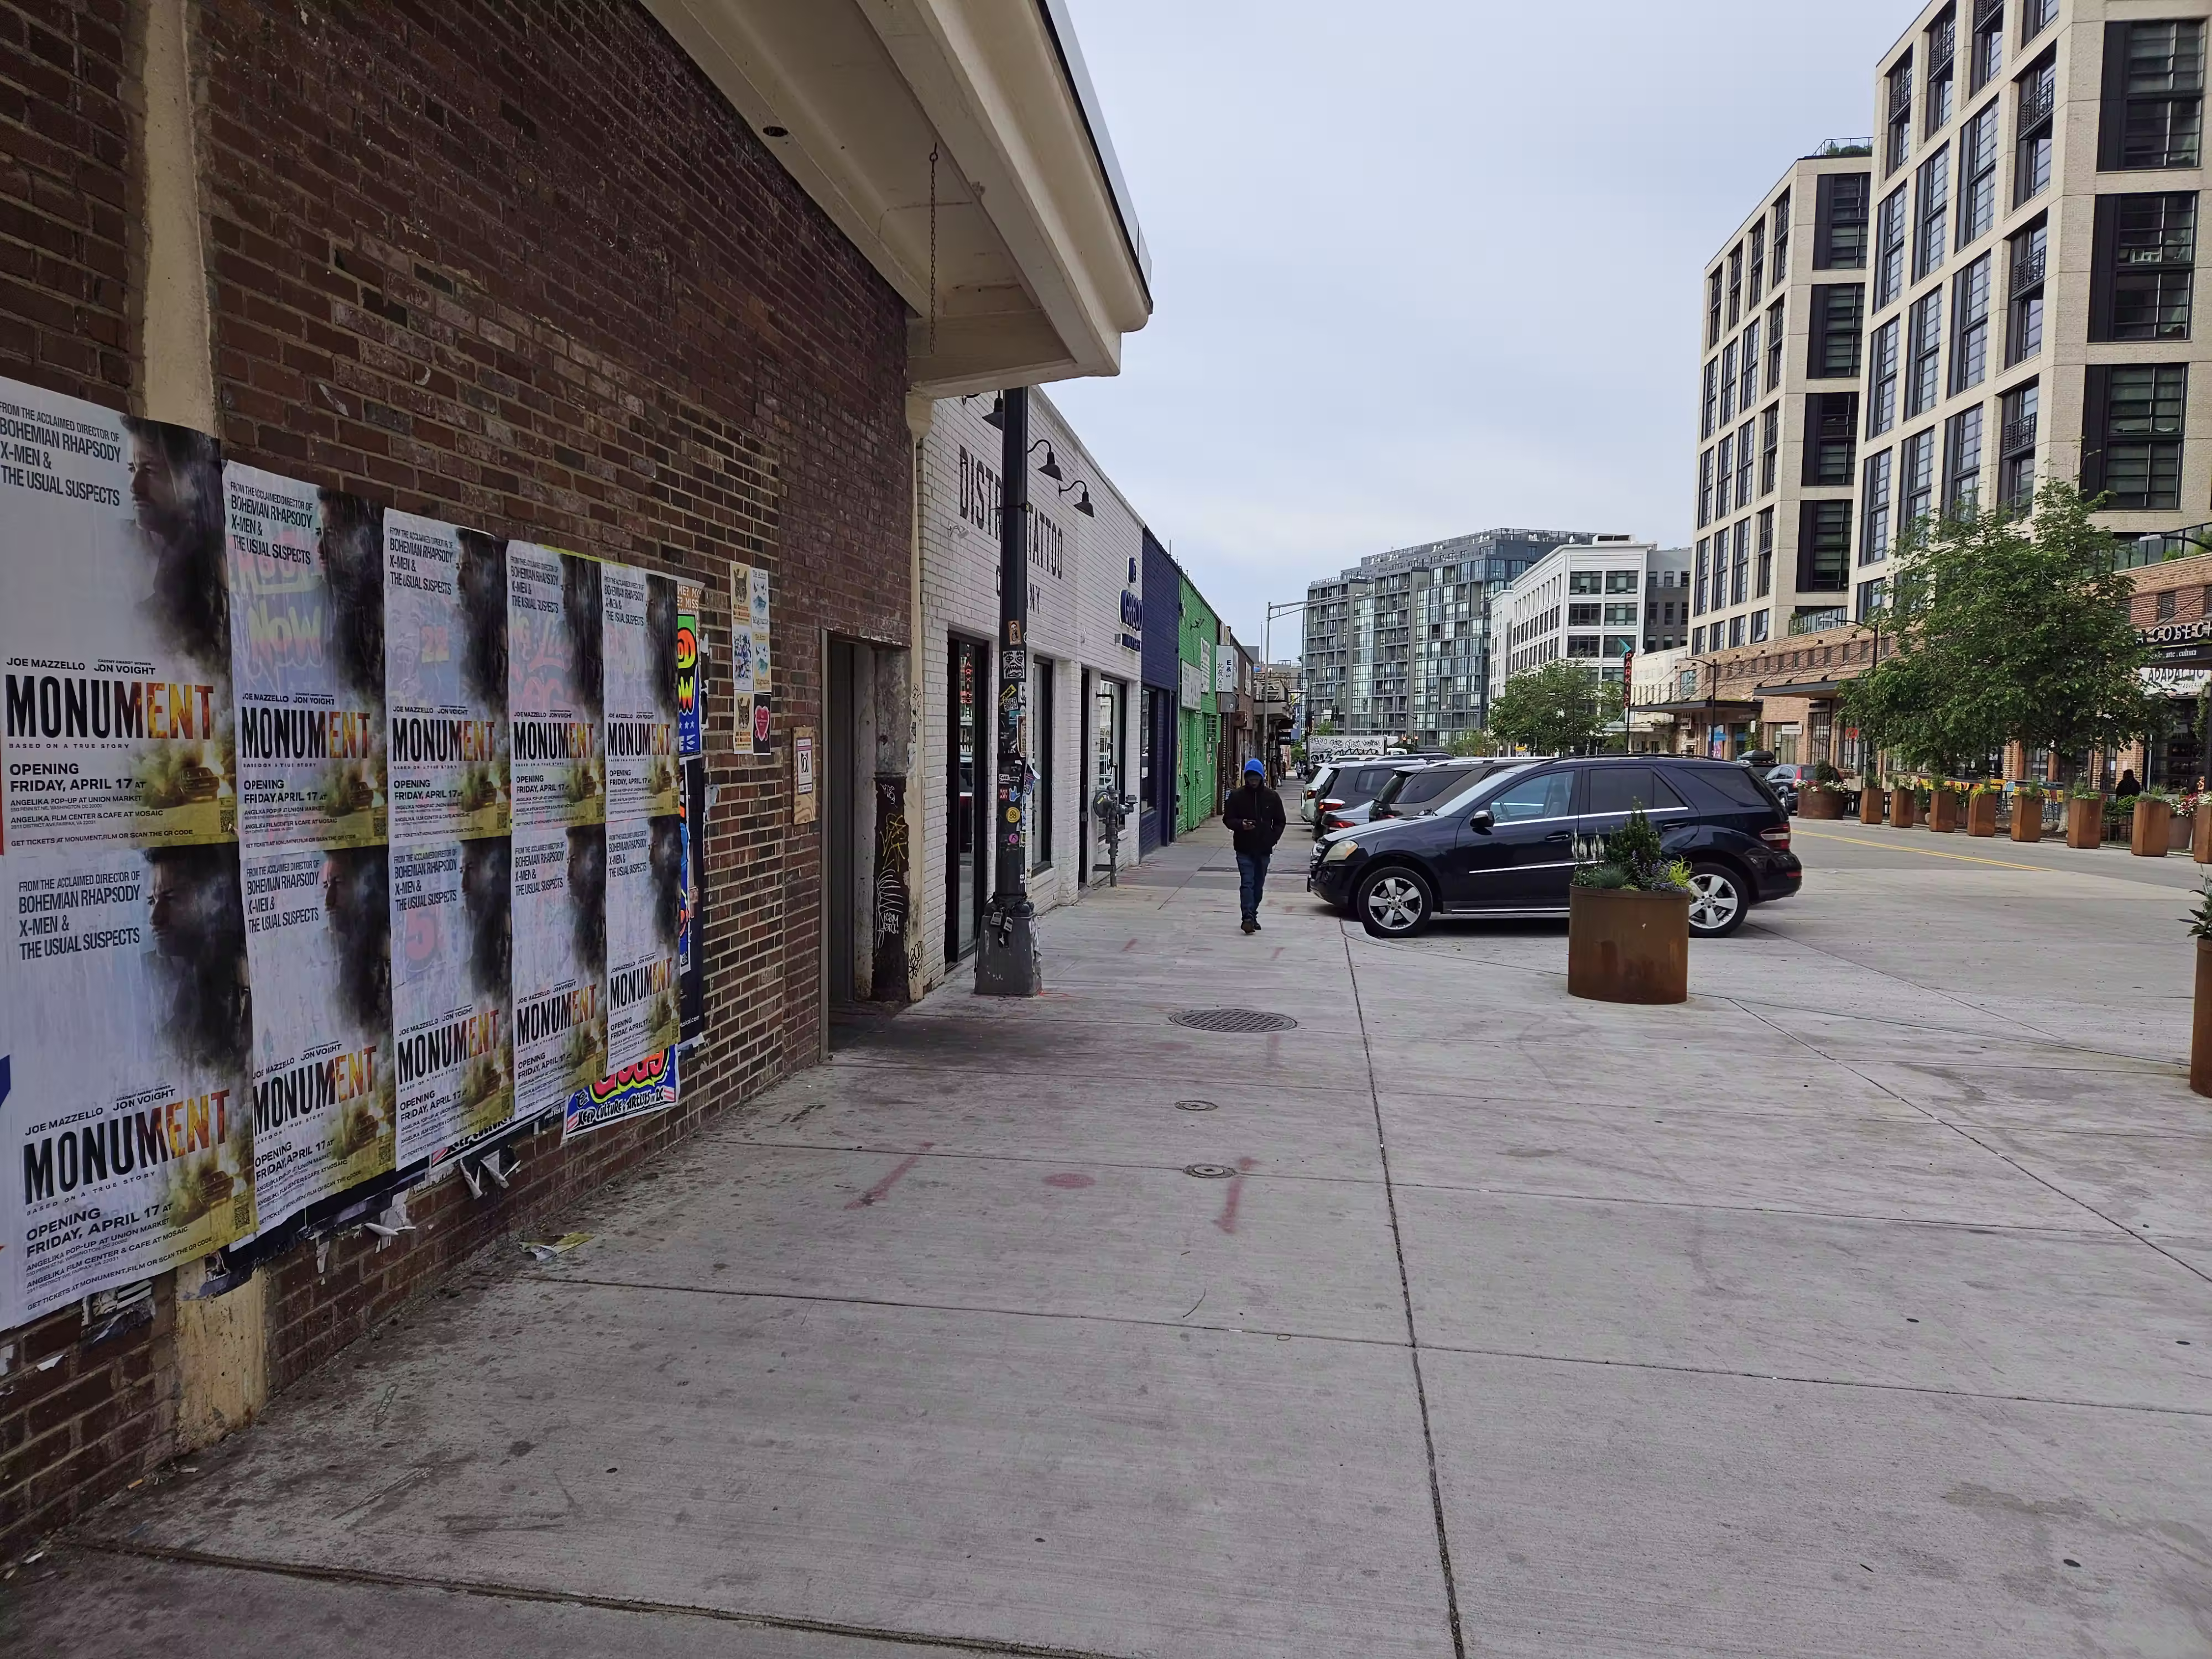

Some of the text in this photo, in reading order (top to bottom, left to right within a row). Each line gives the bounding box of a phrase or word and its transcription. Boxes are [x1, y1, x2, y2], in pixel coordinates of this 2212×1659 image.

[0, 401, 119, 442] FROM THE ACCLAIMED DIRECTOR OF
[0, 417, 121, 463] BOHEMIAN RHAPSODY
[1, 441, 51, 469] X-MEN &
[2, 465, 120, 506] THE USUAL SUSPECTS
[7, 658, 155, 675] JOE MAZZELLO JON VOIGHT
[2179, 649, 2197, 657] cultura
[6, 674, 214, 740] MONUMENT
[242, 707, 371, 759] MONUMENT
[393, 718, 495, 762] MONUMENT
[514, 722, 593, 760] MONUMENT
[608, 722, 671, 757] MONUMENT
[9, 763, 79, 775] OPENING
[394, 779, 430, 789] OPENING
[516, 775, 544, 783] OPENING
[11, 779, 66, 792] FRIDAY,
[70, 779, 112, 790] APRIL
[116, 778, 132, 789] 17
[244, 780, 284, 790] OPENING
[244, 792, 317, 804] FRIDAY, APRIL 17
[394, 791, 424, 800] FRIDAY,
[425, 790, 447, 799] APRIL
[517, 785, 539, 793] FRIDAY,
[11, 815, 49, 823] ANGELIKA
[26, 837, 55, 846] TICKETS
[19, 871, 140, 891] FROM THE ACCLAIMED DIRECTOR OF
[19, 885, 140, 914] BOHEMIAN RHAPSODY
[19, 915, 69, 937] X-MEN &
[20, 927, 139, 960] THE USUAL SUSPECTS
[610, 957, 672, 1011] MONUMENT
[517, 983, 596, 1046] MONUMENT
[611, 1017, 632, 1031] OPENING
[398, 1009, 499, 1085] MONUMENT
[518, 1052, 545, 1069] OPENING
[518, 1056, 558, 1079] FRIDAY, APRIL
[253, 1045, 377, 1137] MONUMENT
[400, 1091, 435, 1110] OPENING
[25, 1089, 175, 1136] JOE MAZZELLO JON VOIGHT
[400, 1091, 461, 1123] FRIDAY, APRIL 17
[578, 1108, 596, 1126] KEEP
[596, 1101, 622, 1119] CULTURE
[627, 1092, 650, 1109] ARTISTS
[23, 1089, 230, 1206] MONUMENT
[255, 1141, 292, 1167] OPENING
[256, 1140, 326, 1181] FRIDAY, APRIL 17
[27, 1202, 58, 1216] BASED
[65, 1196, 75, 1204] ON
[93, 1183, 117, 1196] TRUE
[123, 1171, 155, 1186] STORY
[26, 1208, 101, 1241] OPENING
[27, 1204, 173, 1258] FRIDAY, APRIL 17 AT
